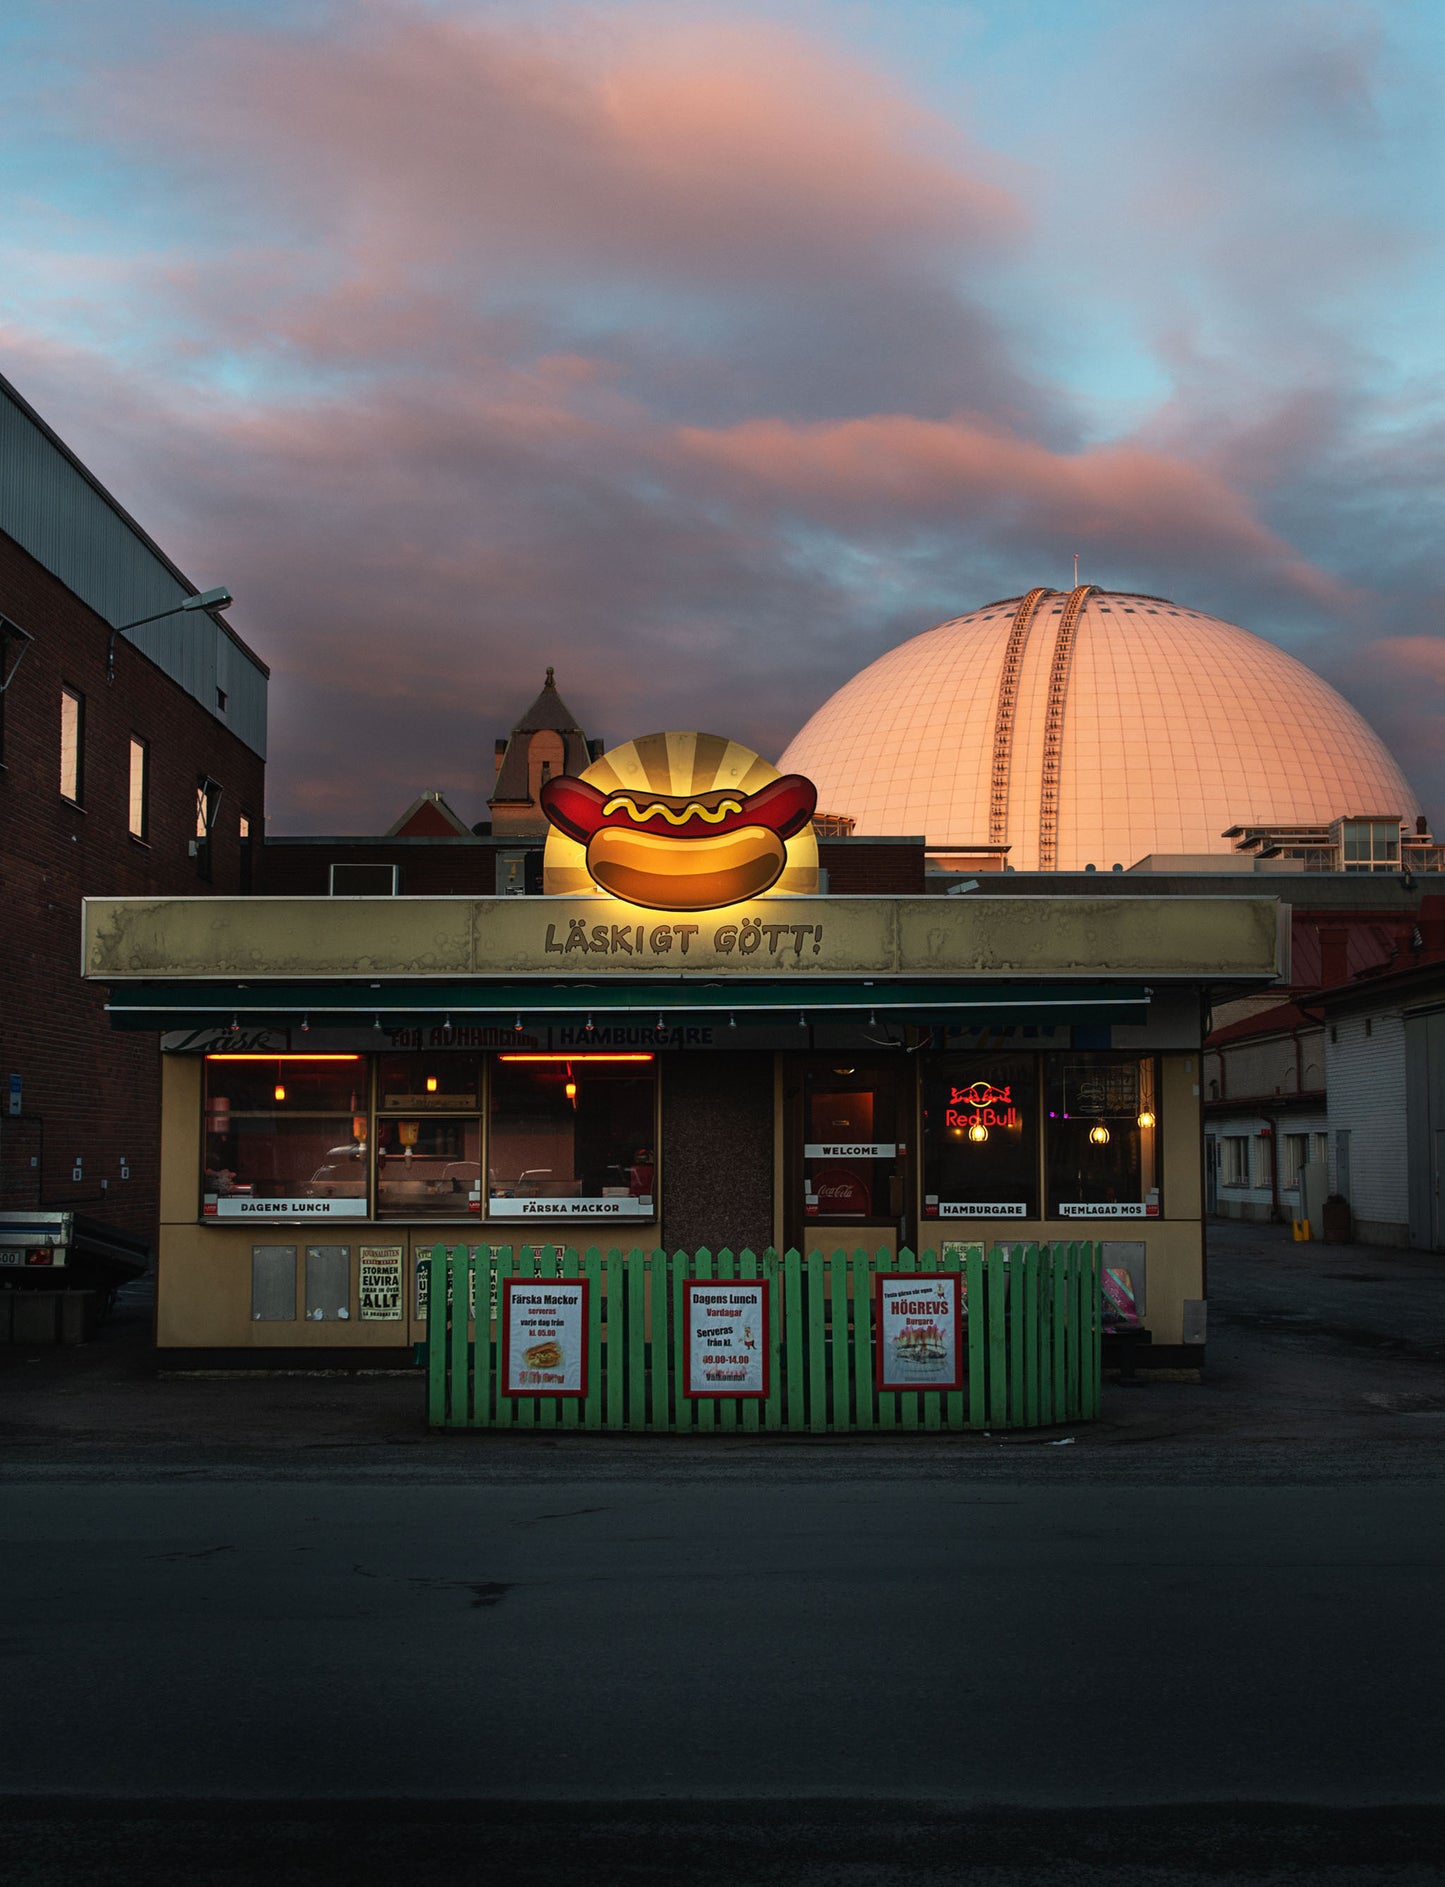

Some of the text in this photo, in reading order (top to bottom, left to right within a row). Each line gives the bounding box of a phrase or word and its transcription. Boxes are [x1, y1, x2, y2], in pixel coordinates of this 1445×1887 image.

[545, 917, 823, 956] LÄSKIGT GÖTT!
[559, 1026, 713, 1045] HAMBURGARE
[945, 1106, 1017, 1127] Red Bull
[822, 1147, 879, 1155] WELCOME
[241, 1203, 331, 1212] DAGENS LUNCH
[523, 1201, 620, 1213] FÄRSKA MACKOR
[943, 1205, 1023, 1215] HAMBURGARE
[1063, 1205, 1142, 1215] HEMLAGAD MOS
[362, 1266, 398, 1275] STORMEN
[362, 1275, 399, 1286] ELVIRA
[362, 1293, 399, 1308] ALLT
[511, 1294, 578, 1305] Färska Mackor
[693, 1293, 757, 1305] Dagens Lunch
[706, 1308, 743, 1317] Vardagar
[891, 1299, 949, 1315] HÖGREVS
[520, 1318, 565, 1327] varje dag från
[906, 1317, 934, 1326] Burgare
[696, 1326, 734, 1338] Serveras
[707, 1338, 732, 1347] från kl.
